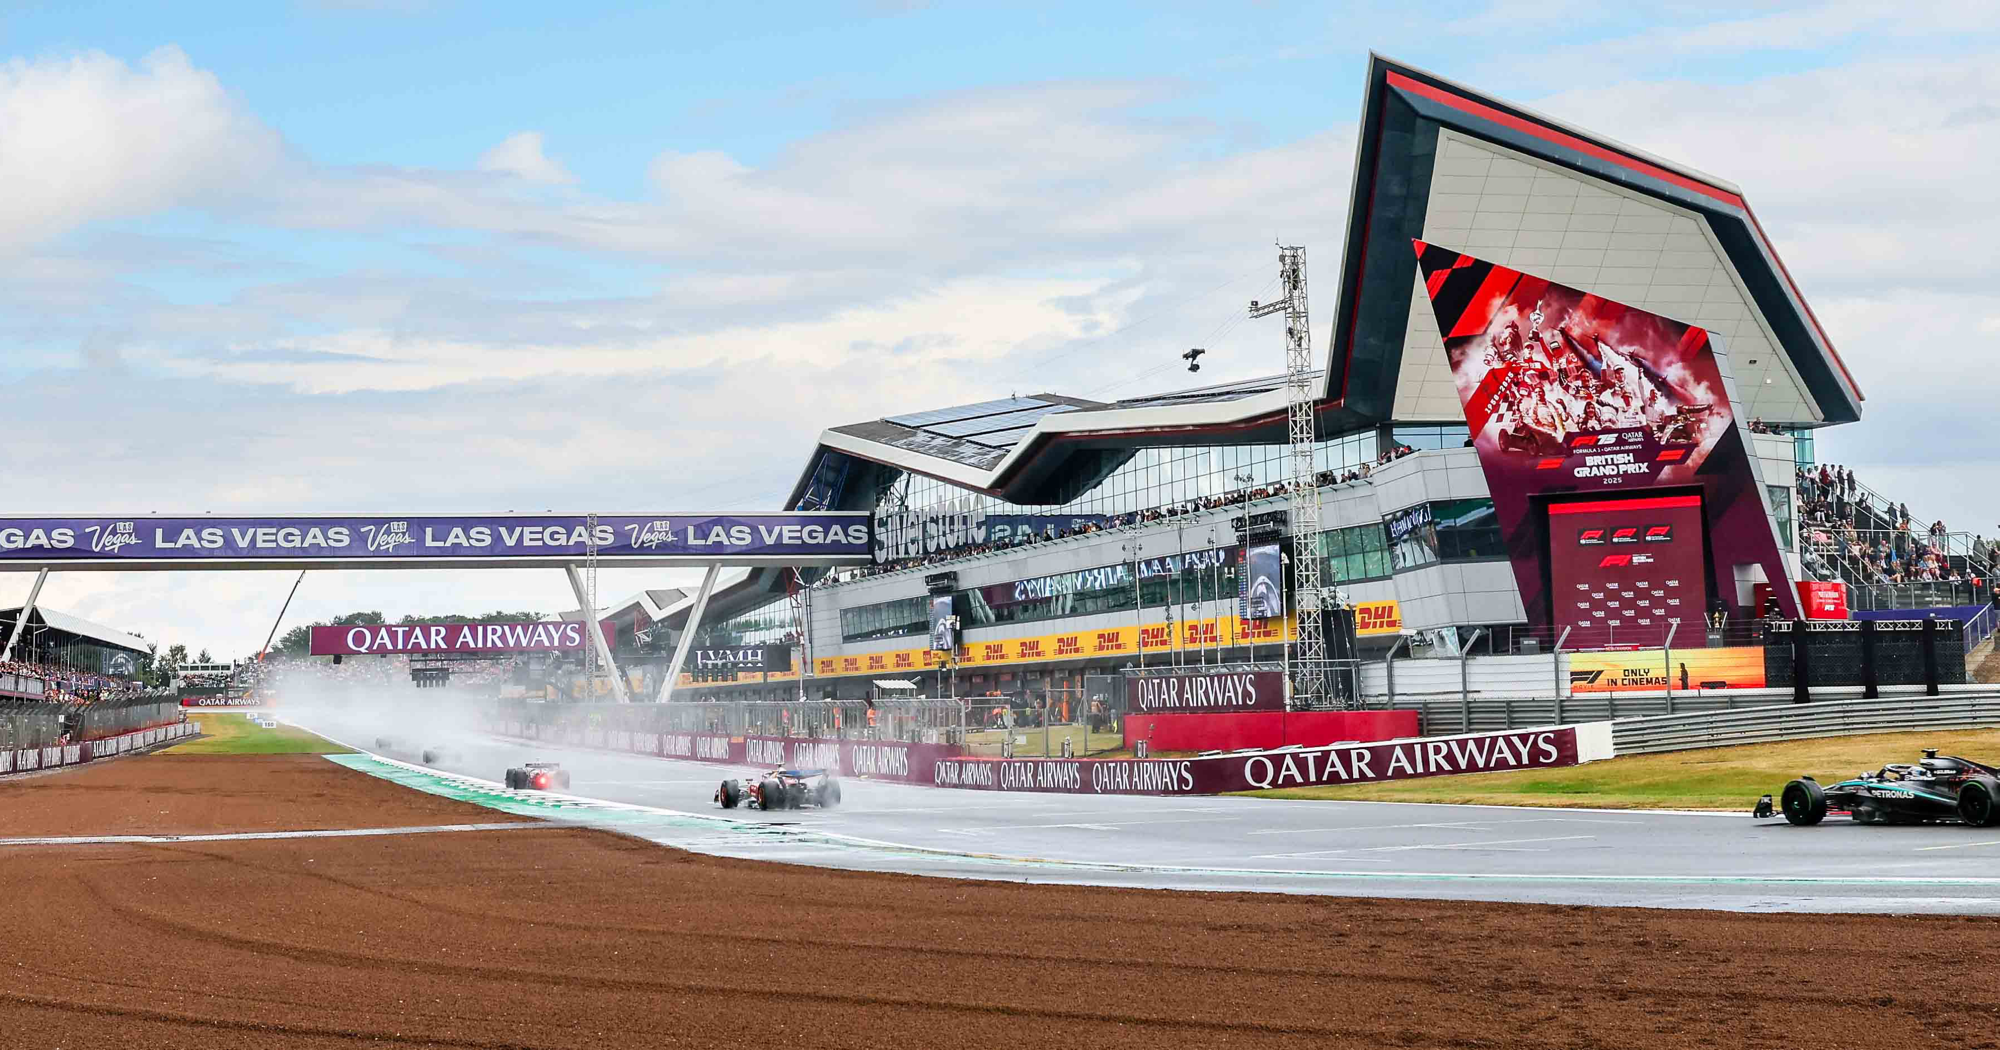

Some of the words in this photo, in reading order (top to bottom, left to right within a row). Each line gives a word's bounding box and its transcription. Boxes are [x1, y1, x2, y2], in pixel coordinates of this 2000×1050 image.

[1622, 431, 1643, 440] QATAR
[1574, 464, 1618, 477] GRAND
[1619, 462, 1650, 474] PRIX
[1585, 453, 1634, 466] BRITISH
[117, 522, 133, 532] LAS
[391, 522, 407, 532] LAS
[625, 523, 678, 549] Vegas
[654, 521, 669, 531] LAS
[688, 526, 751, 545] LAS
[758, 525, 868, 545] VEGAS
[874, 493, 985, 564] Silverstone
[85, 524, 142, 553] Vegas
[155, 527, 224, 548] LAS
[231, 527, 350, 549] VEGAS
[360, 524, 416, 552] Vegas
[425, 527, 492, 547] LAS
[499, 526, 614, 547] VEGAS
[1359, 606, 1398, 630] DHL
[347, 627, 448, 653] QATAR
[455, 624, 580, 649] AIRWAYS
[1141, 627, 1168, 647] DHL
[1188, 623, 1218, 643] DHL
[1241, 620, 1272, 639] DHL
[1020, 641, 1042, 658] DHL
[1057, 637, 1080, 655] DHL
[1097, 632, 1121, 651] DHL
[696, 650, 764, 667] LVMH
[895, 653, 912, 667] DHL
[985, 644, 1006, 660] DHL
[1607, 678, 1620, 686] IN
[1621, 677, 1667, 686] CINEMAS
[1623, 669, 1650, 677] ONLY
[227, 698, 260, 706] AIRWAYS
[1138, 678, 1180, 711] QATAR
[1183, 674, 1256, 707] AIRWAYS
[696, 736, 712, 758] QATAR
[746, 739, 763, 762] QATAR
[764, 740, 784, 764] AIRWAYS
[794, 741, 812, 767] QATAR
[813, 743, 839, 770] AIRWAYS
[853, 745, 876, 775] QATAR
[878, 746, 908, 776] AIRWAYS
[1244, 749, 1376, 788] QATAR
[1387, 733, 1559, 776] AIRWAYS
[935, 761, 959, 784] QATAR
[961, 763, 992, 786] AIRWAYS
[1000, 761, 1033, 789] QATAR
[1037, 762, 1080, 789] AIRWAYS
[1092, 763, 1130, 793] QATAR
[1132, 761, 1193, 791] AIRWAYS
[1872, 790, 1915, 799] PETRONAS
